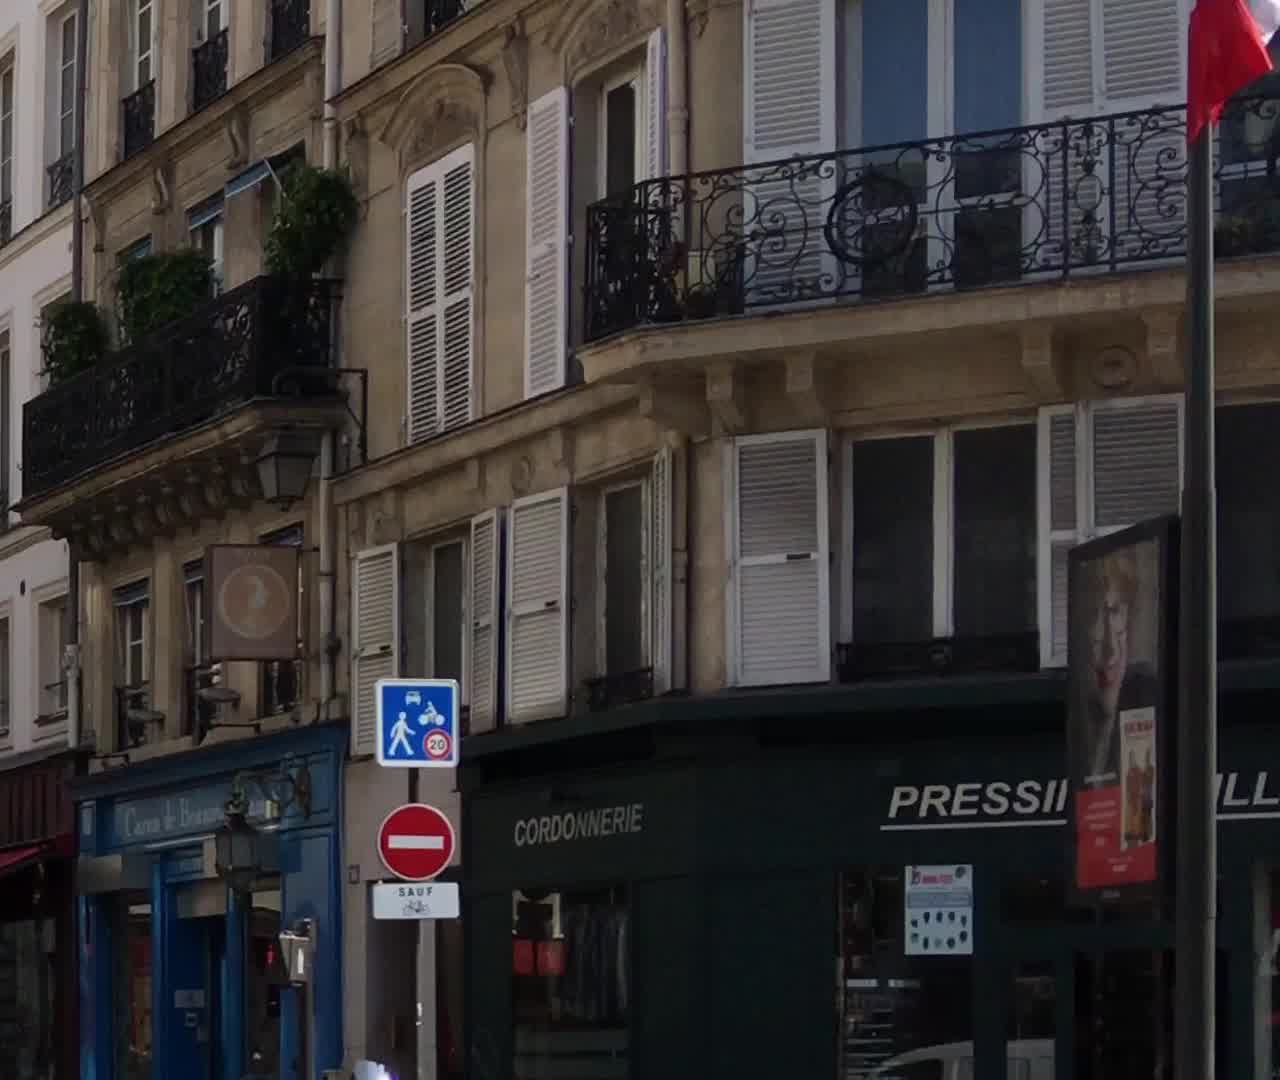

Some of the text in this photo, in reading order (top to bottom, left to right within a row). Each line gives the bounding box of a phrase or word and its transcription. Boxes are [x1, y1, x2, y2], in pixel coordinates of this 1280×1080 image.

[430, 739, 445, 751] 20
[513, 802, 644, 848] CORDONNERIE
[398, 886, 433, 897] SAUF
